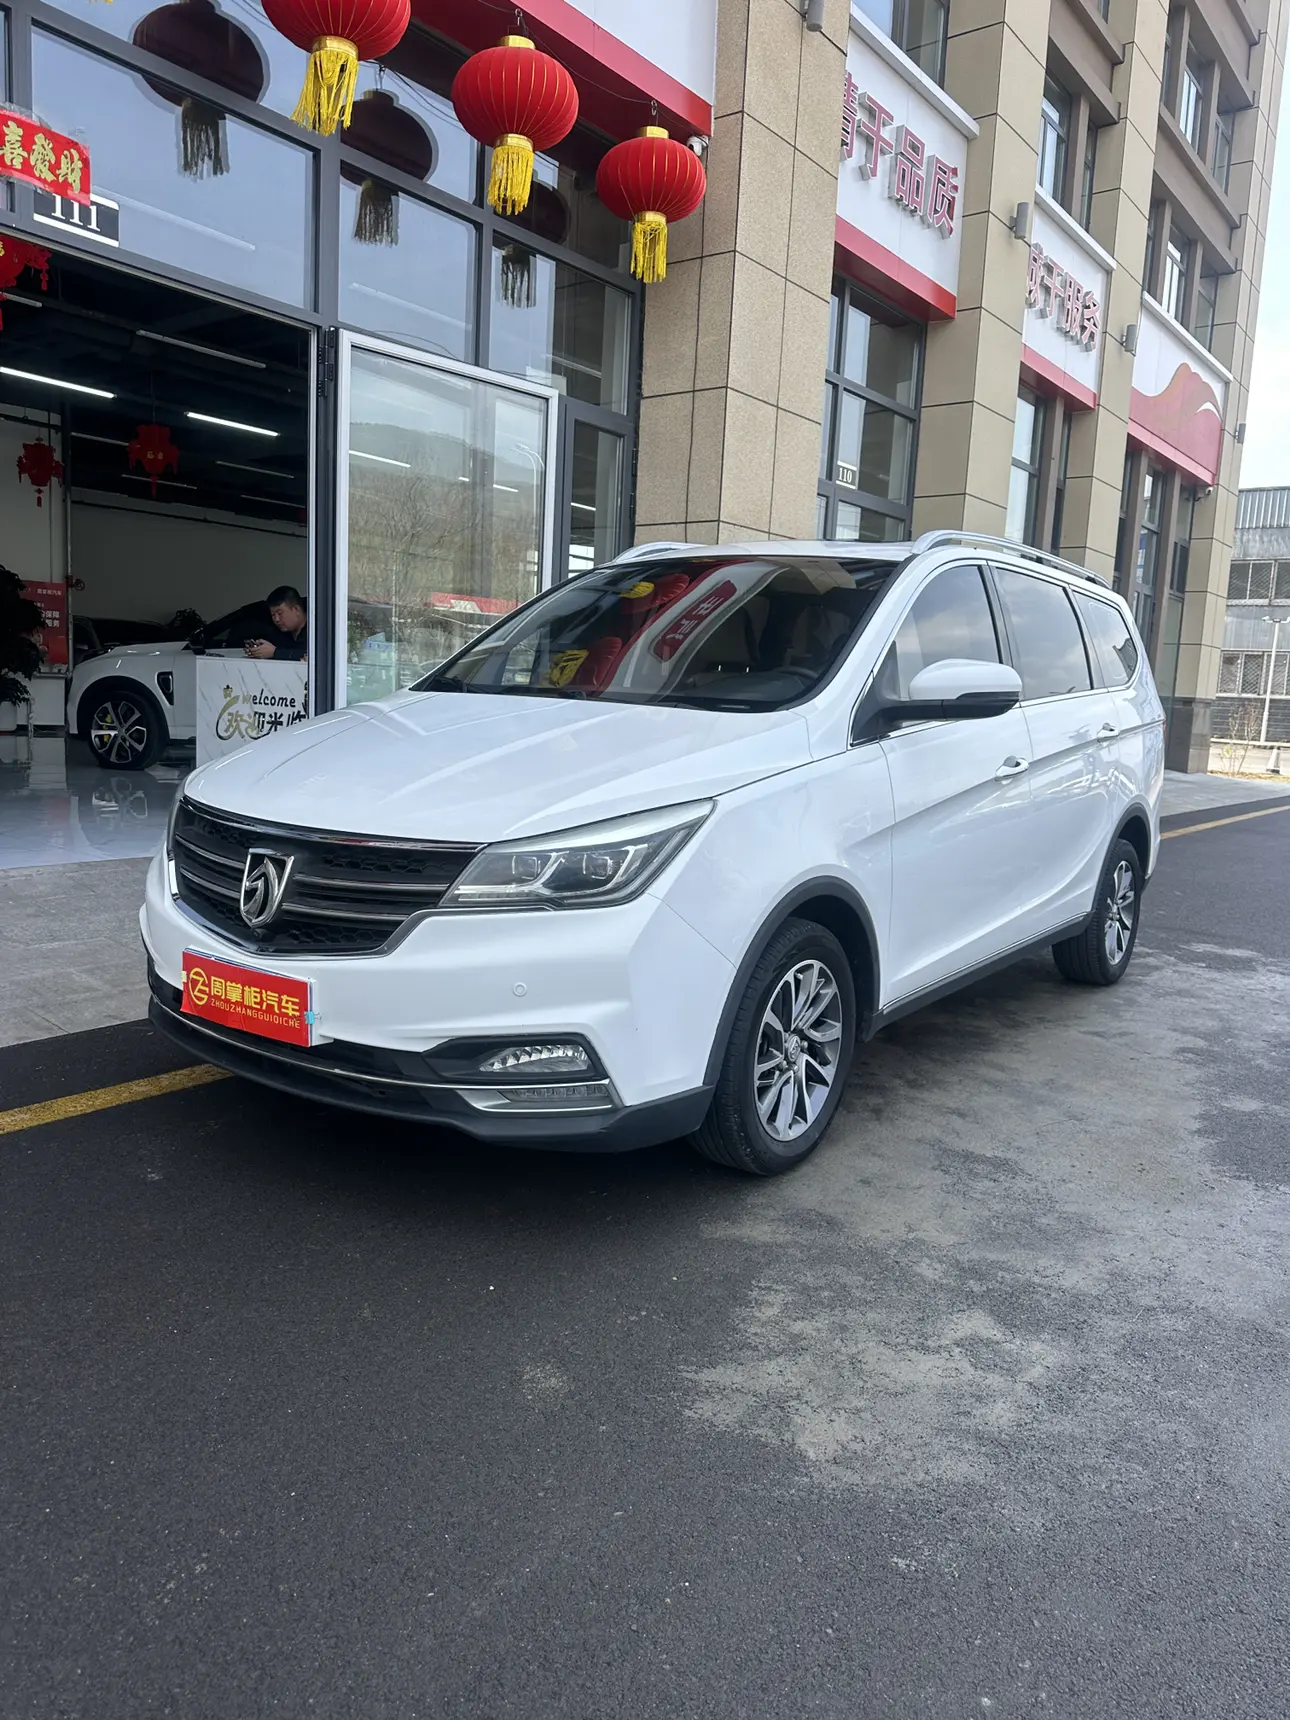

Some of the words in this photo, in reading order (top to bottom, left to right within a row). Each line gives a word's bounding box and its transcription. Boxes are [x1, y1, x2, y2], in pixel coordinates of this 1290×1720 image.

[839, 467, 853, 483] 110
[210, 975, 300, 1017] 周掌柜汽车
